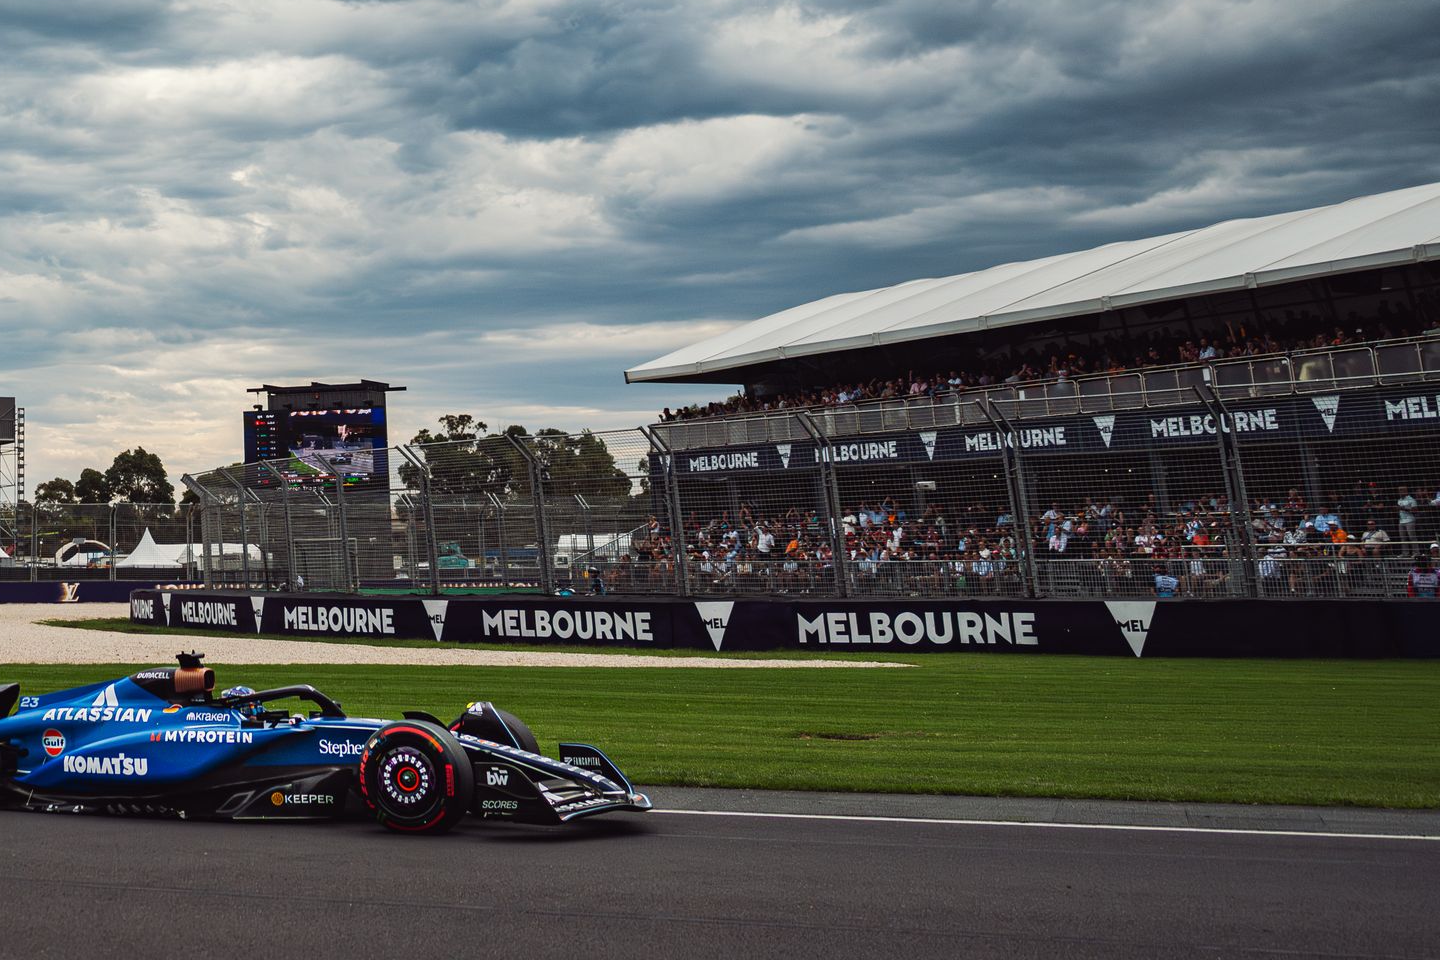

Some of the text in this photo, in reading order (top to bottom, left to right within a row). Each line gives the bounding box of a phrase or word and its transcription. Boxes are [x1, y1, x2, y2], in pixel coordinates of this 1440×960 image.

[689, 451, 759, 472] MELBOURNE
[181, 601, 238, 626] MELBOURNE
[283, 605, 396, 634] MELBOURNE
[482, 608, 654, 641] MELBOURNE
[703, 617, 727, 629] MEL
[796, 611, 1039, 645] MELBOURNE
[1116, 619, 1149, 633] MEL
[137, 671, 170, 680] DURACELL
[20, 696, 40, 708] 23
[42, 707, 153, 722] ATLASSIAN
[195, 711, 231, 722] kraken
[43, 737, 65, 747] Gulf
[164, 730, 253, 744] MYPROTEIN
[319, 739, 365, 758] Stephe
[63, 752, 148, 776] KOMATSU
[284, 794, 334, 804] KEEPER
[482, 800, 518, 809] SCORES
